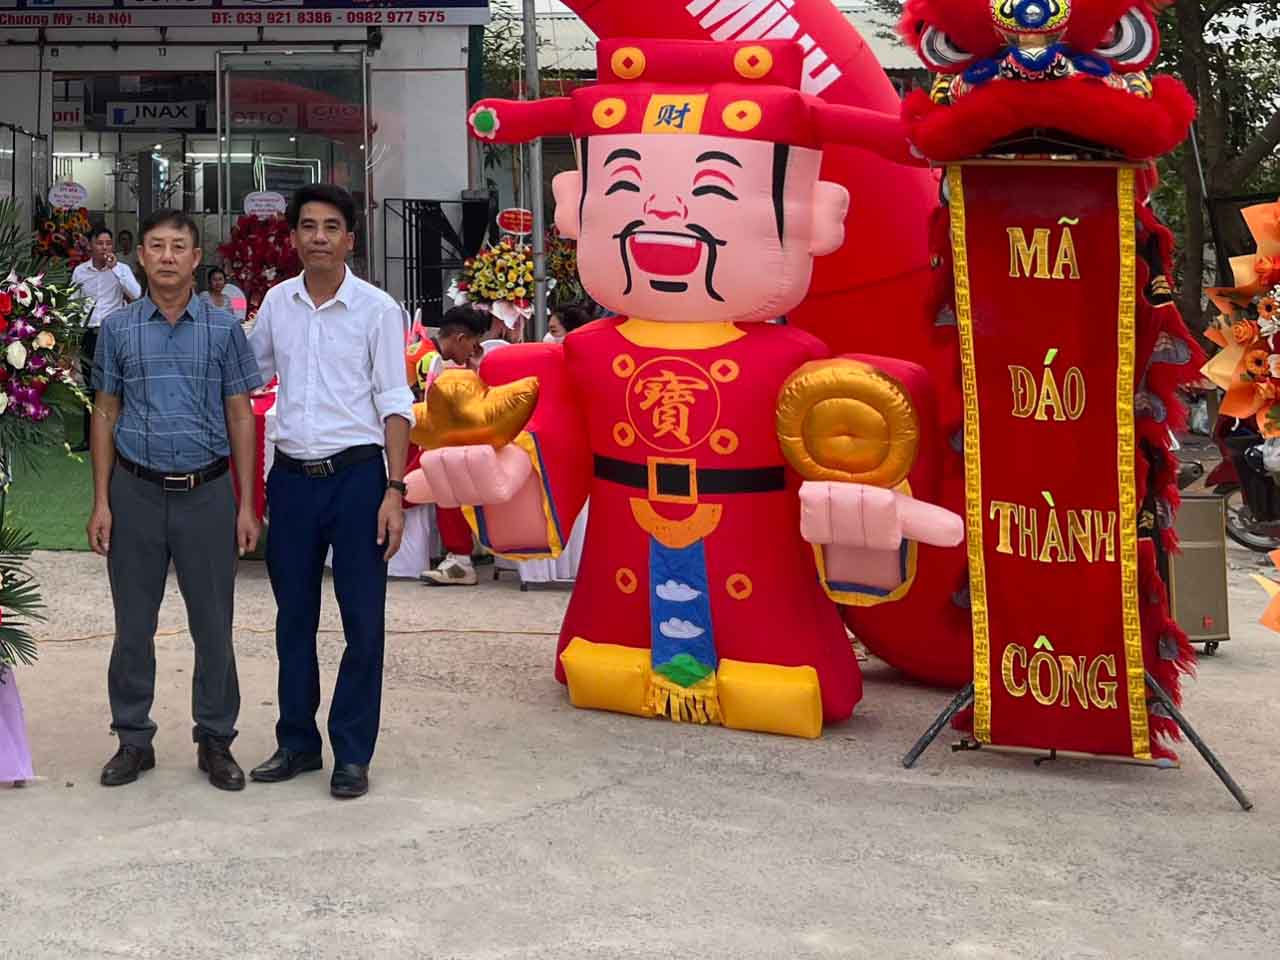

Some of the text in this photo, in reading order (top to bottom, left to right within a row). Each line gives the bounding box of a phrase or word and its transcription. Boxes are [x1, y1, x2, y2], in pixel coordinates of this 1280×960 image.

[237, 12, 261, 24] 033
[267, 12, 291, 24] 921
[298, 12, 332, 24] 8386
[347, 11, 382, 24] 0982
[387, 11, 413, 24] 977
[419, 11, 445, 23] 575
[135, 105, 188, 119] INAX
[652, 102, 690, 129] 财
[1006, 216, 1081, 280] MÃ
[1008, 348, 1086, 421] ĐÁO
[990, 490, 1117, 563] THÀNH
[1001, 635, 1118, 711] CÔNG
